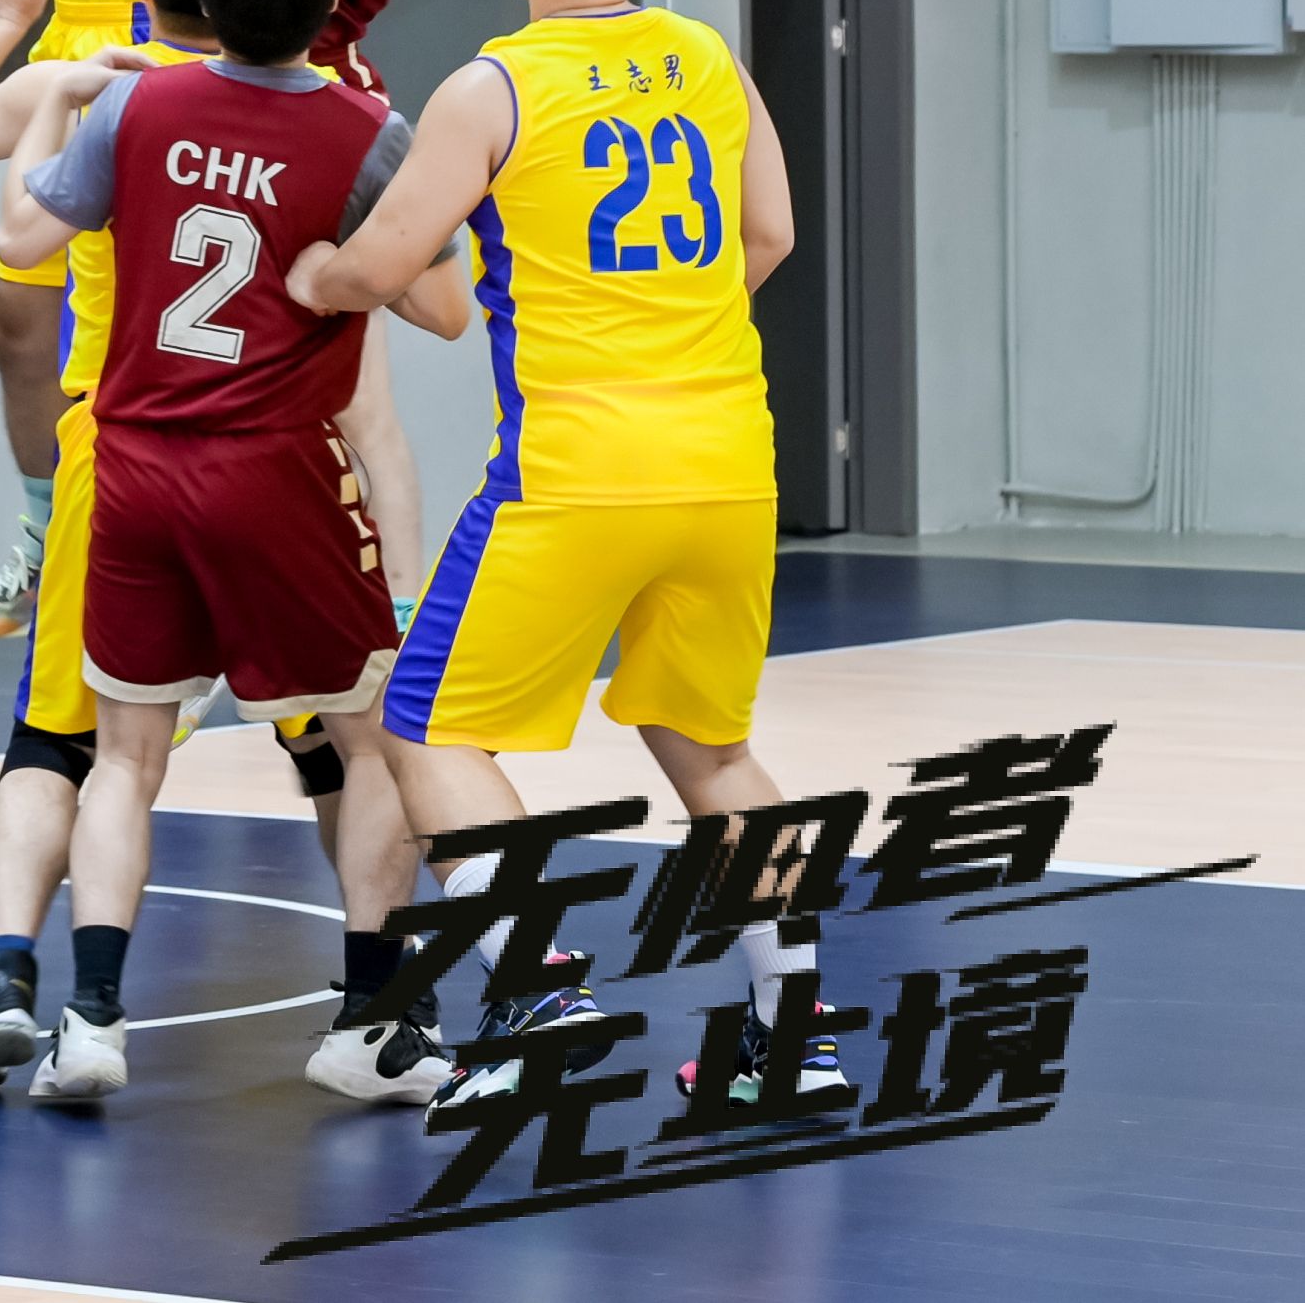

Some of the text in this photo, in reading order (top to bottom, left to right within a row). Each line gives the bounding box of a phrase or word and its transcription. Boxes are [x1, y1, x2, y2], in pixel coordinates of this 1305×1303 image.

[165, 139, 287, 207] CHK
[583, 112, 723, 274] 23
[156, 202, 262, 365] 2
